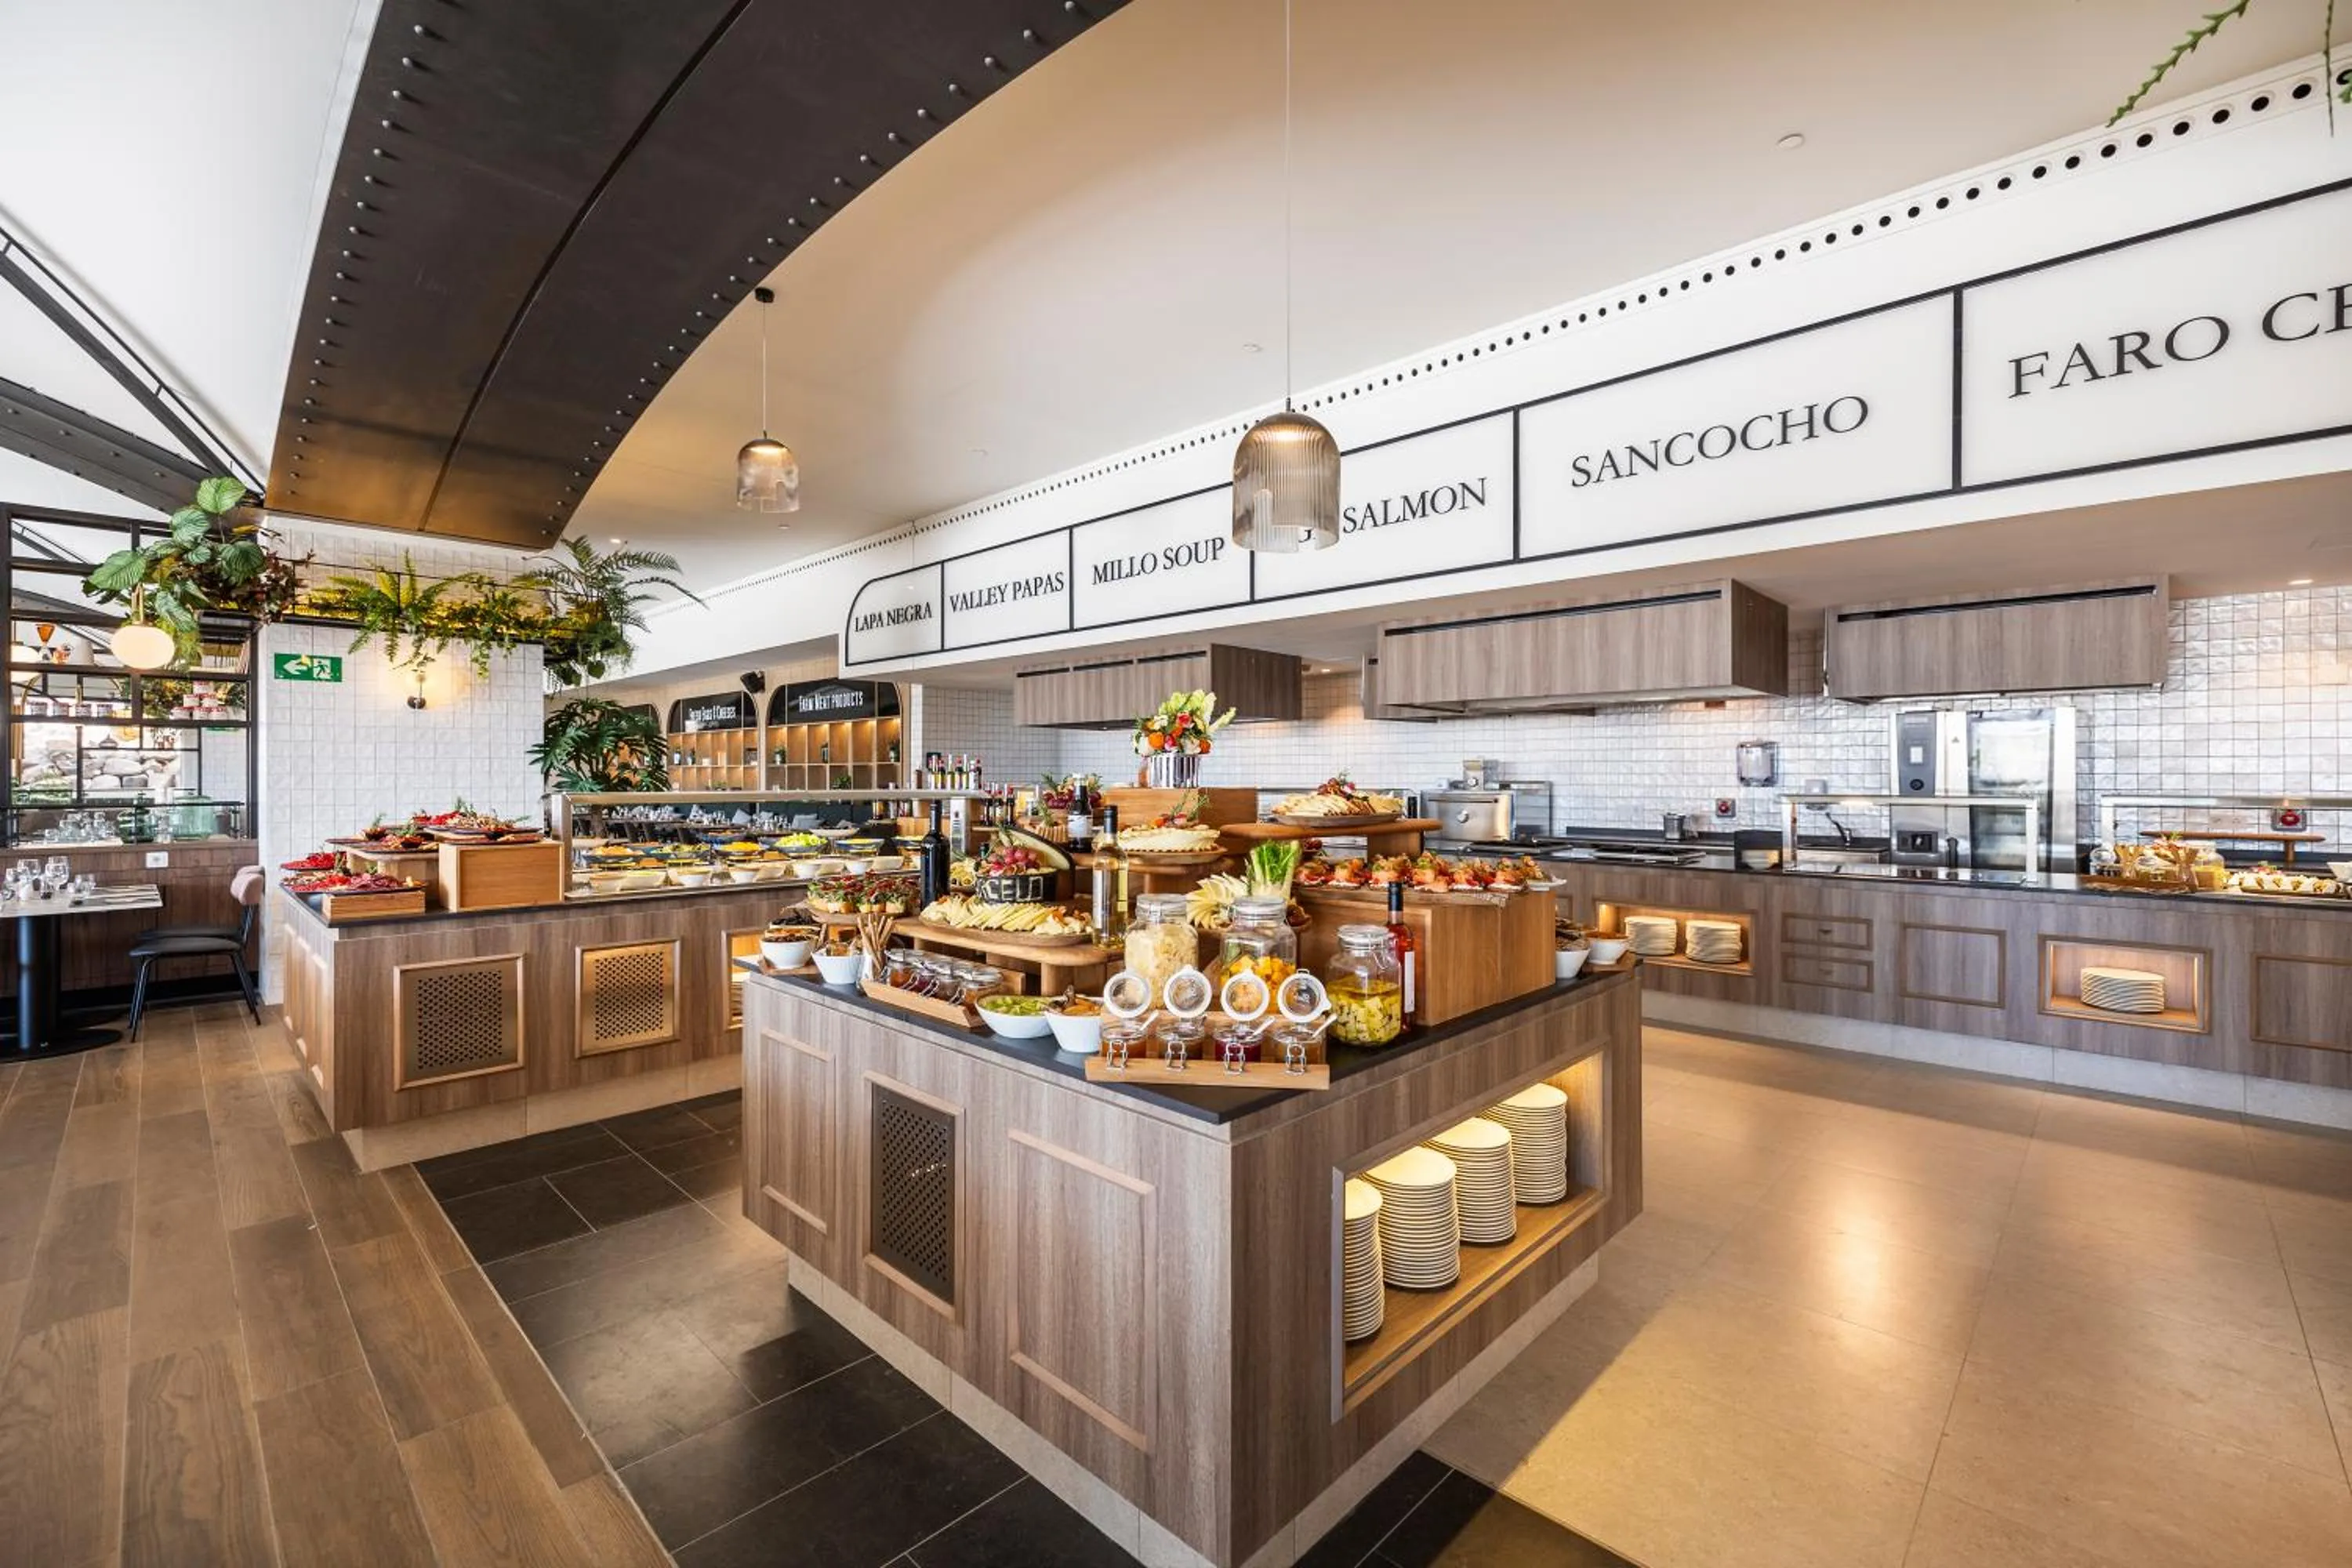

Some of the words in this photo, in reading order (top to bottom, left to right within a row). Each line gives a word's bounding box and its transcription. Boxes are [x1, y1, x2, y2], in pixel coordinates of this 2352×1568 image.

[2007, 315, 2230, 398] FARO
[1571, 395, 1869, 488] SANCOCHO
[1342, 477, 1487, 534] SALMON
[1092, 551, 1158, 586] MILLO
[1163, 537, 1225, 570] SOUP
[855, 612, 884, 633] LAPA
[887, 601, 933, 626] NEGRA
[949, 583, 1008, 613] VALLEY
[1012, 571, 1065, 601] PAPAS
